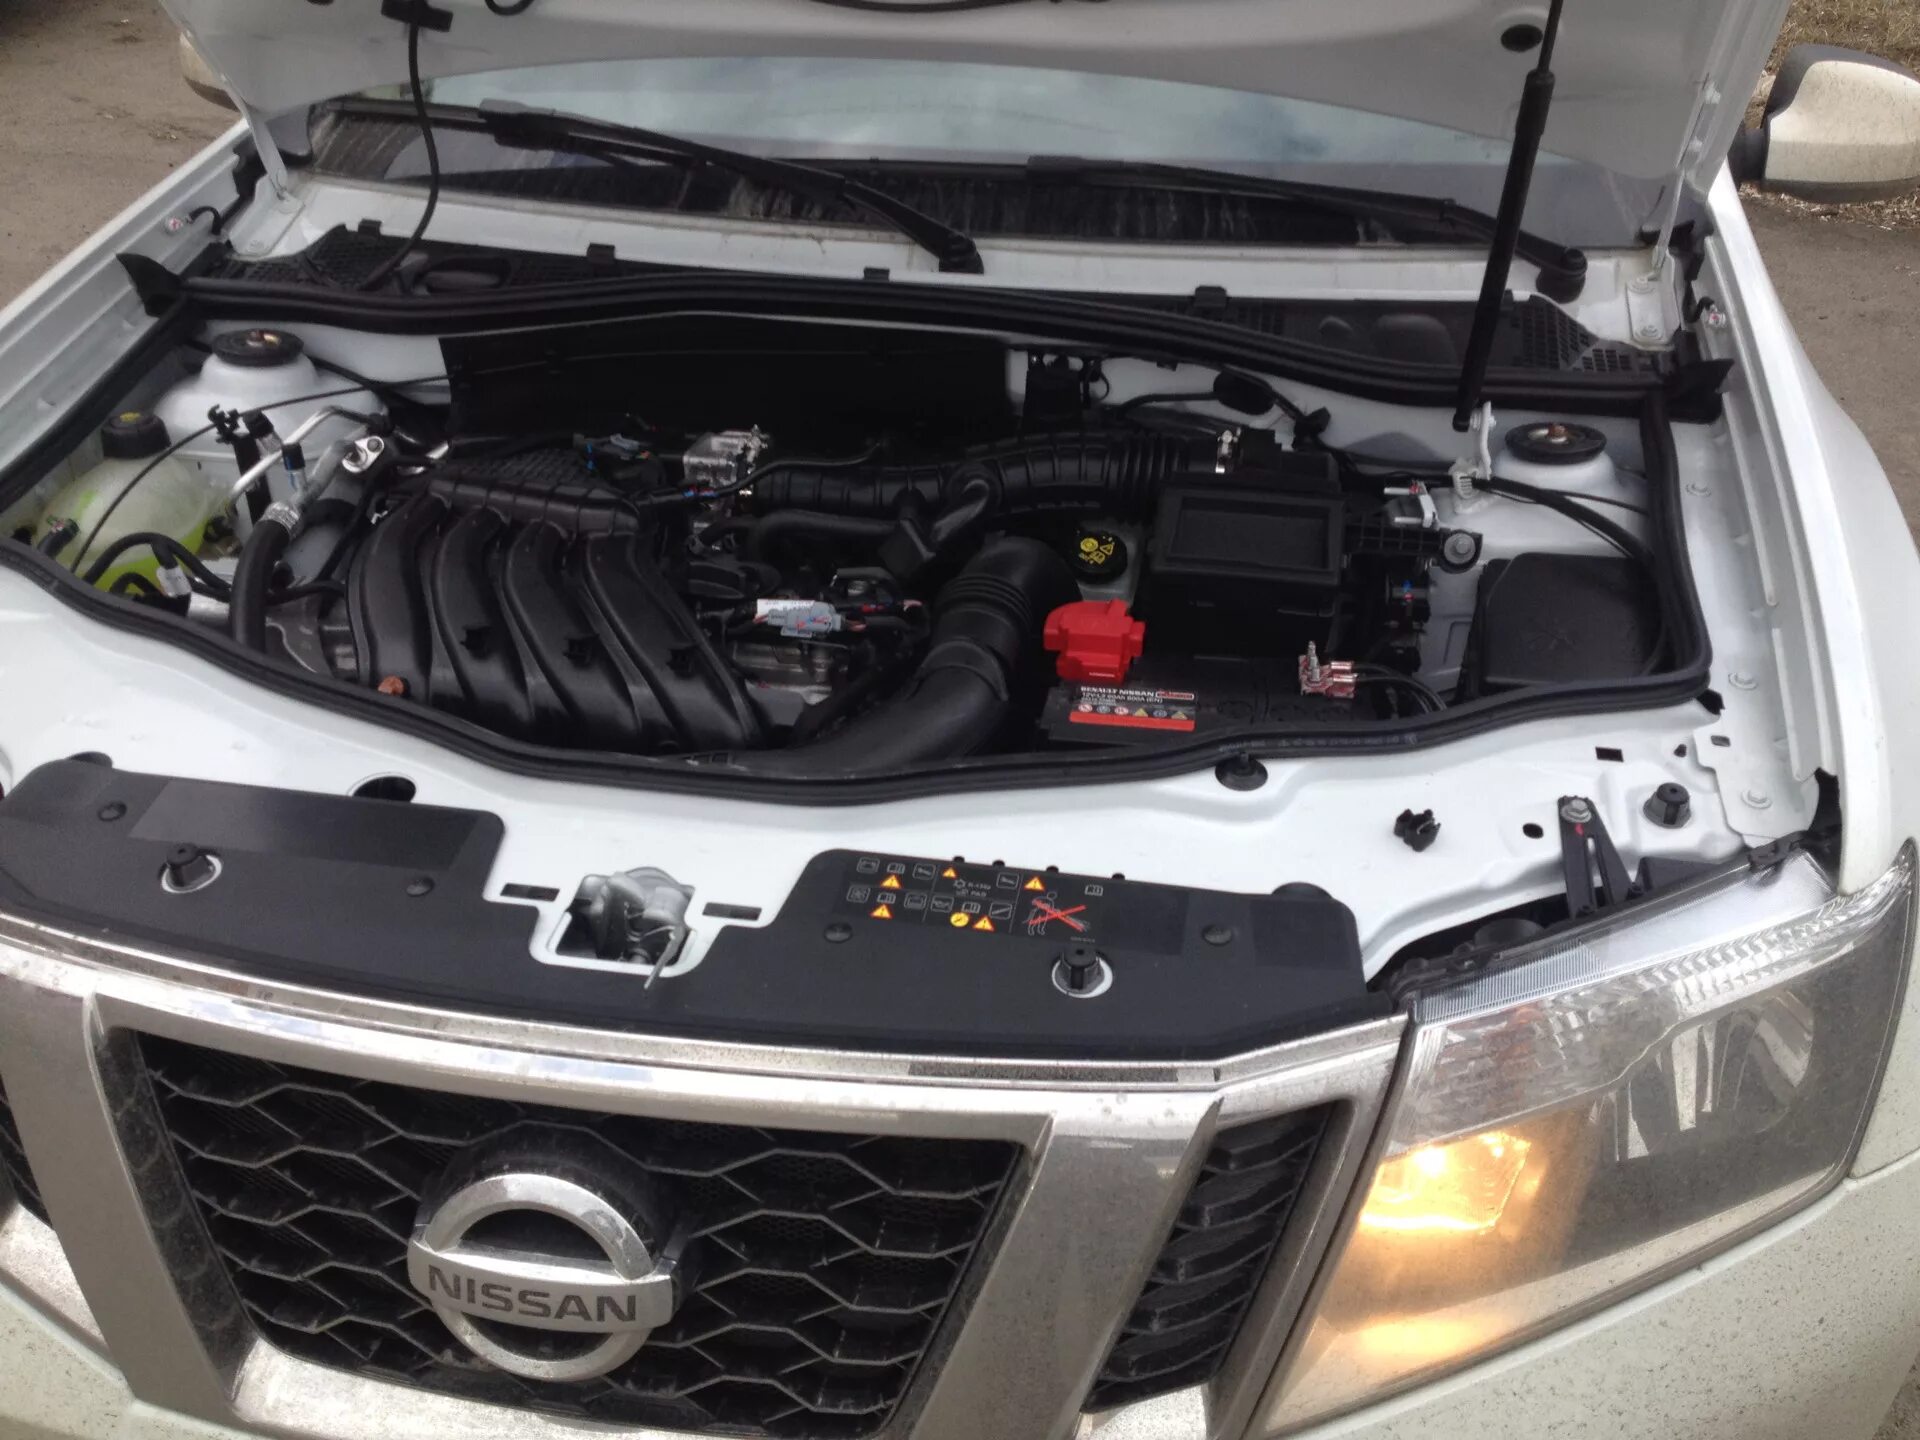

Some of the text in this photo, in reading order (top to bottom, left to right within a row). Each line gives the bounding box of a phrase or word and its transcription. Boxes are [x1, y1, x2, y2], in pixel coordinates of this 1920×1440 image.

[1080, 686, 1118, 695] RENAULT
[1119, 689, 1155, 698] NISSAN
[428, 1264, 636, 1322] NISSAN
